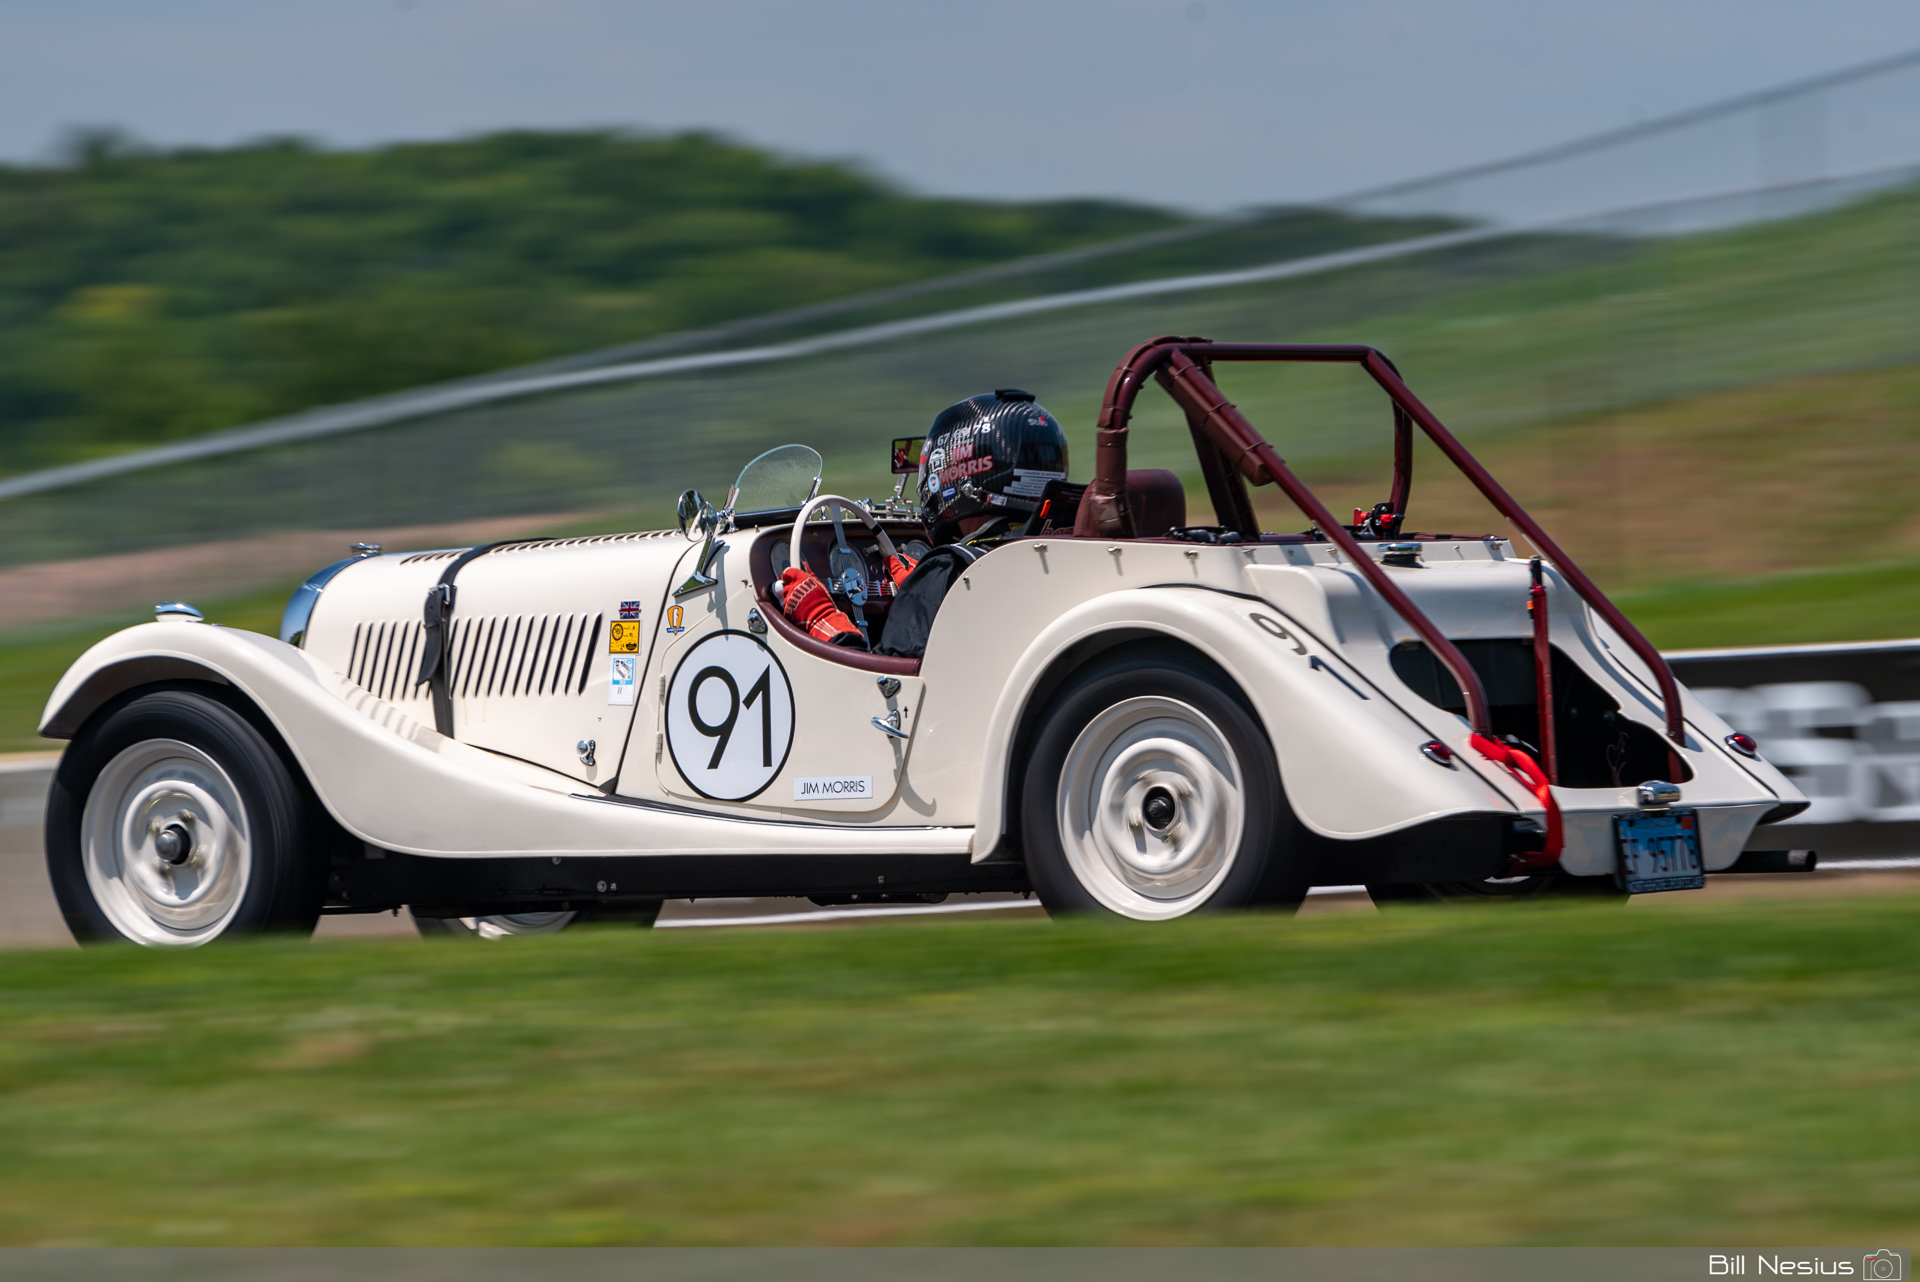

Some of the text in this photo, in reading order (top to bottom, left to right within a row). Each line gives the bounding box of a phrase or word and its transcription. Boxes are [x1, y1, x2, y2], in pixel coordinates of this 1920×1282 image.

[937, 432, 950, 446] 67
[973, 422, 991, 435] 78
[950, 443, 974, 466] JIM
[938, 455, 994, 486] MORRIS
[1249, 612, 1372, 701] 91
[687, 664, 773, 770] 91
[801, 780, 866, 796] JIM MORRIS
